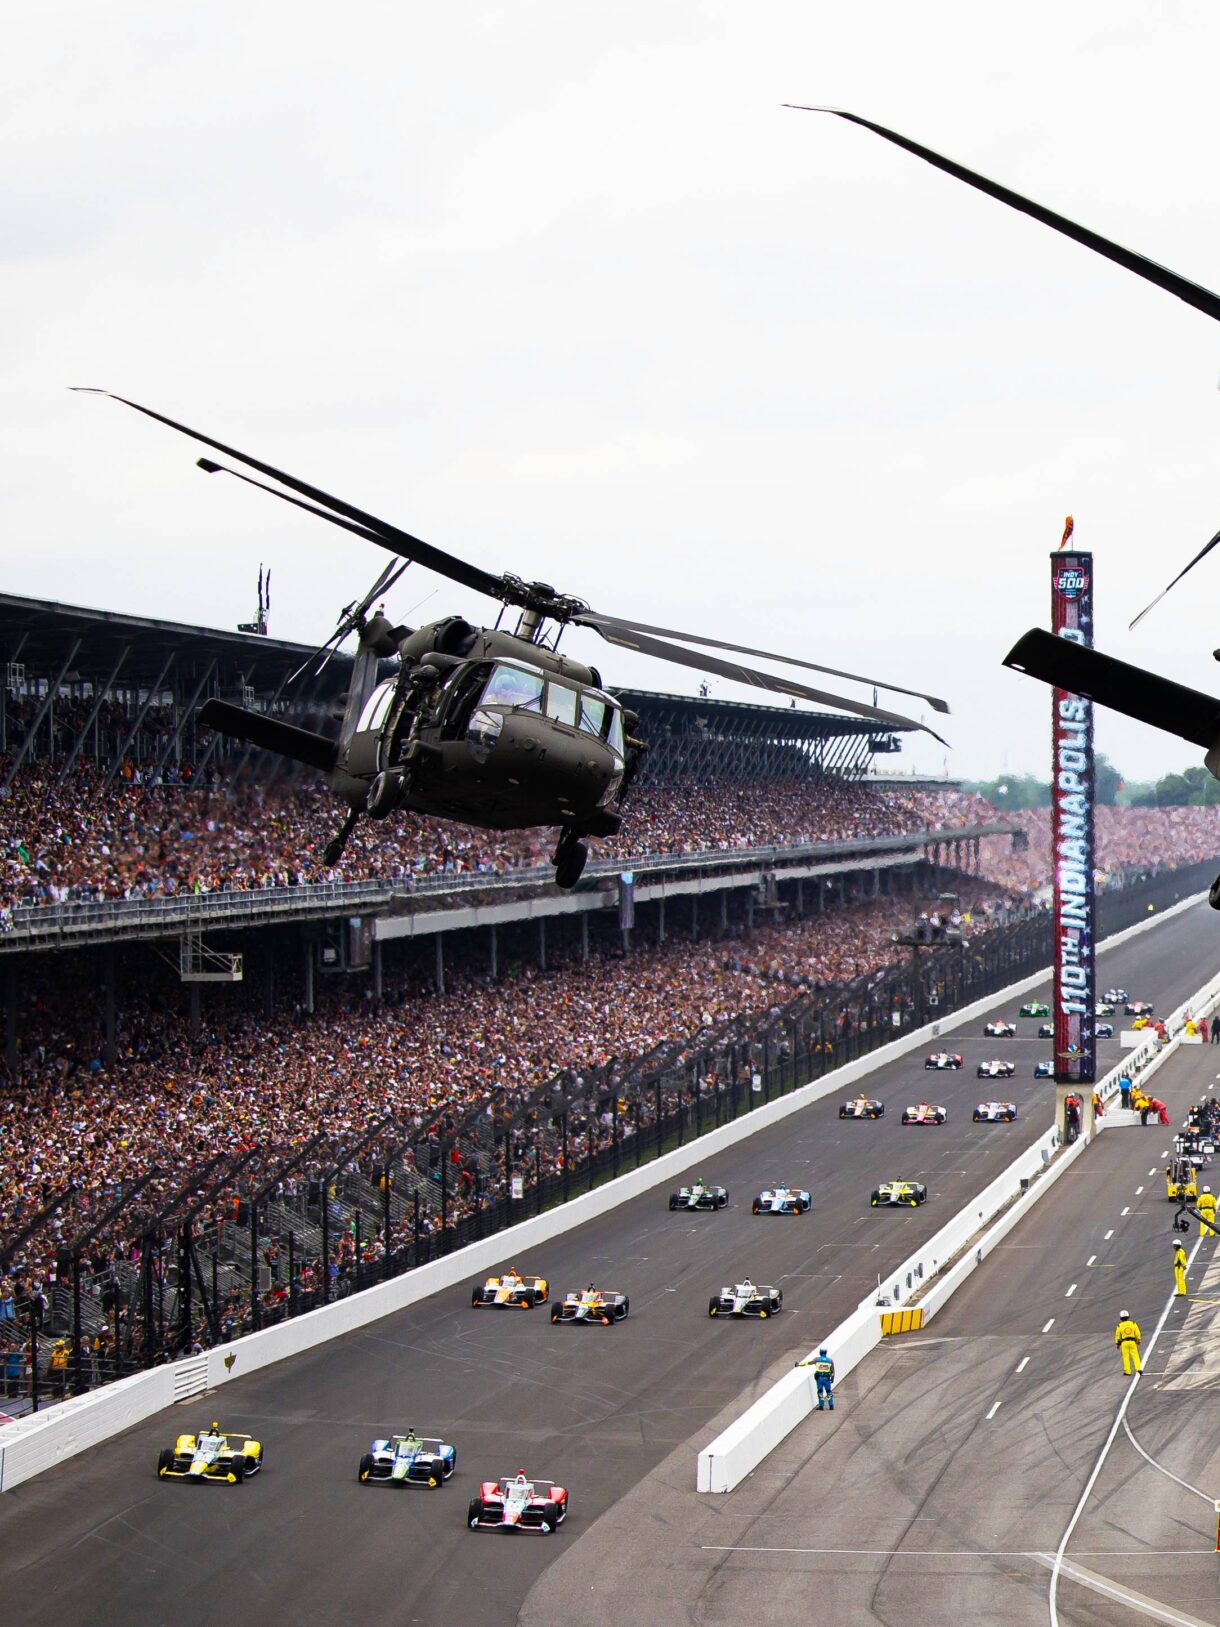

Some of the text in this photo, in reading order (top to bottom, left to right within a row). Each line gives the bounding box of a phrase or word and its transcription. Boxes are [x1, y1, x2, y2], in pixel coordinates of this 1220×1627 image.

[1058, 578, 1085, 589] 500
[1058, 699, 1087, 929] INDIANAPOLIS
[1060, 936, 1087, 1015] 110TH
